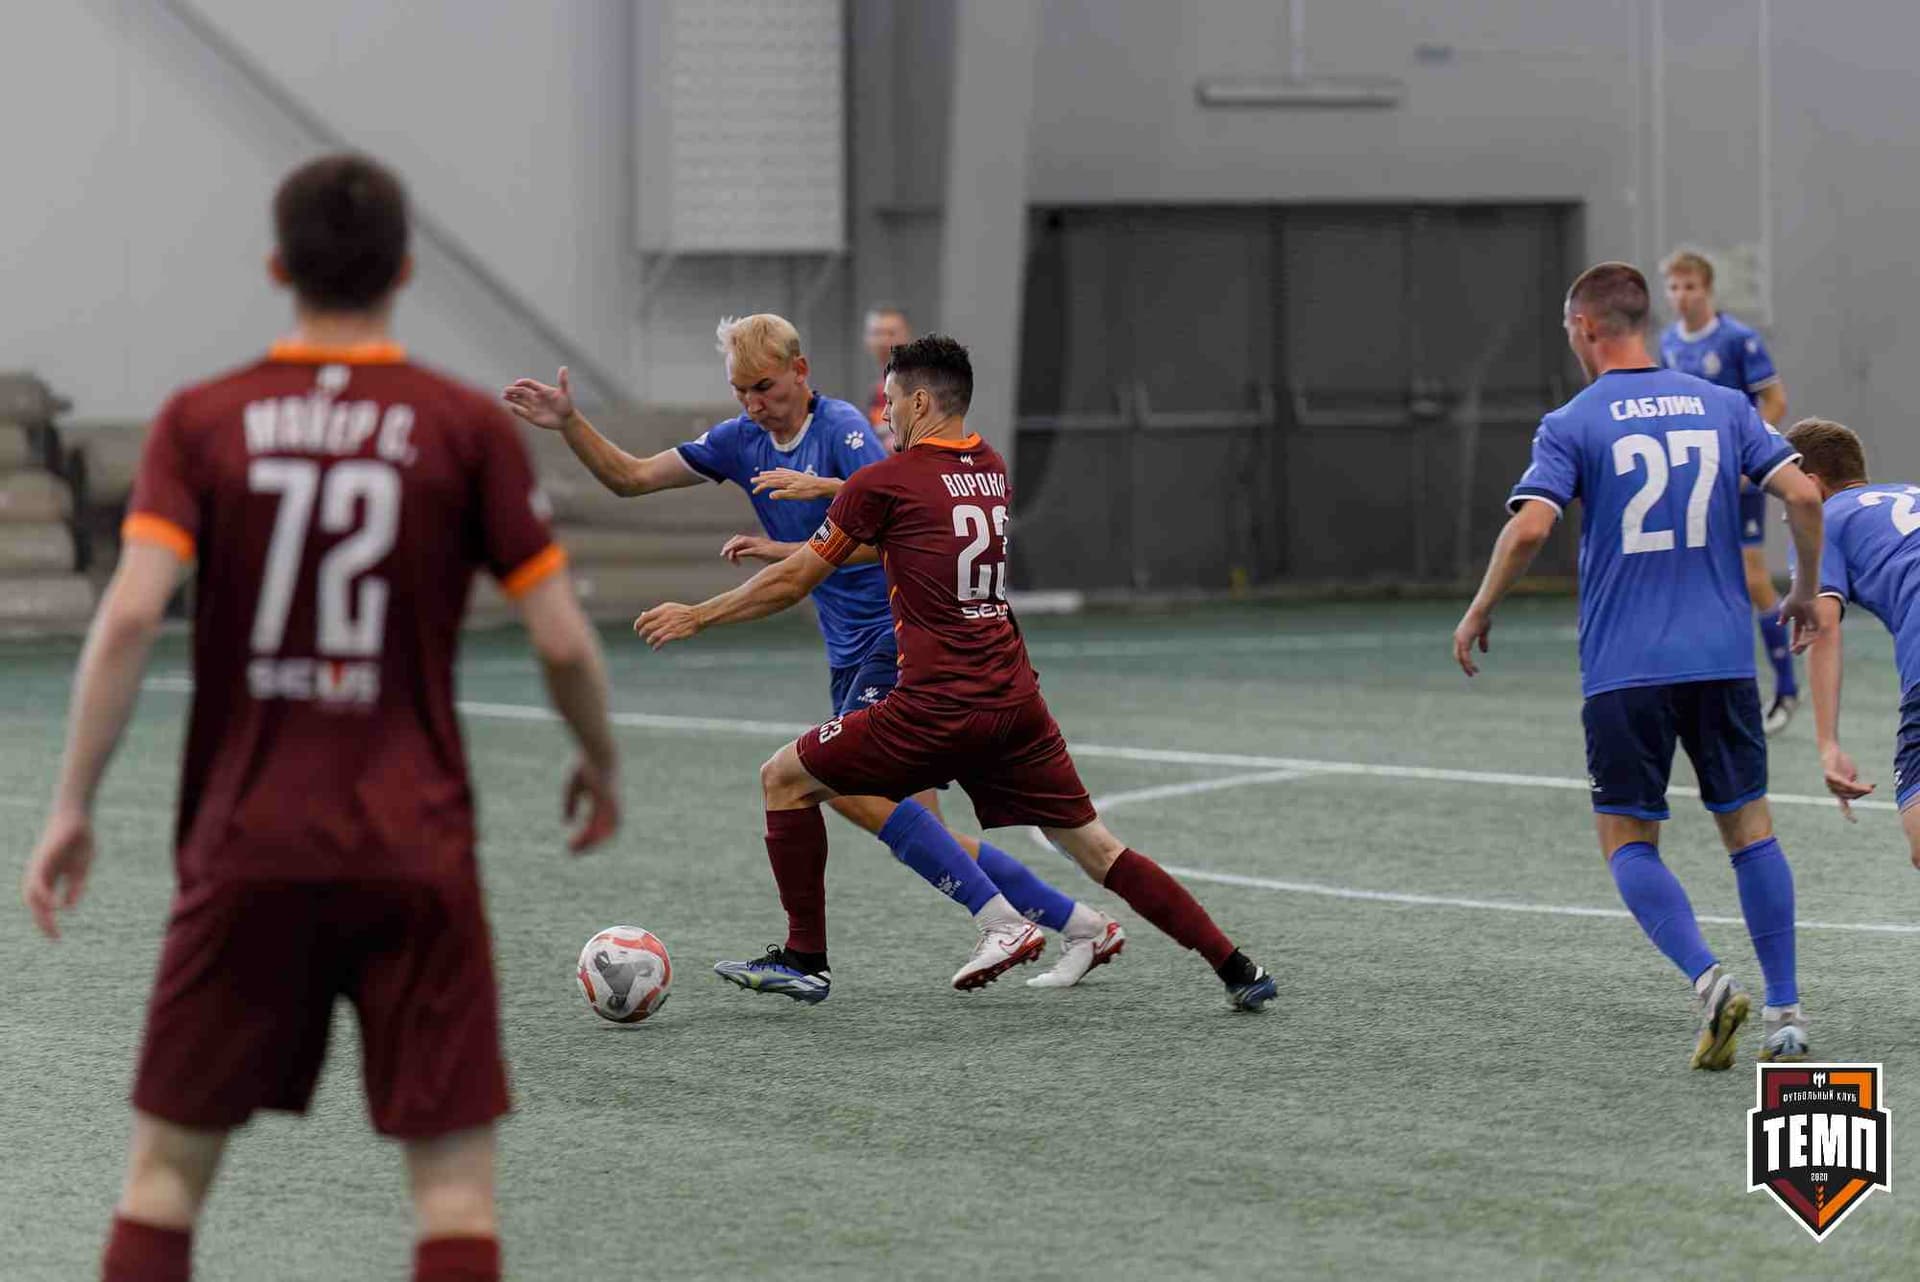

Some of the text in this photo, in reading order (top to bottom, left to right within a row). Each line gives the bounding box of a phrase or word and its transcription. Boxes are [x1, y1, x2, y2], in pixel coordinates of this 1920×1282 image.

[1609, 395, 1706, 421] САБЛИН
[1611, 429, 1720, 555] 27
[1857, 485, 1920, 536] 2
[247, 457, 400, 656] 72
